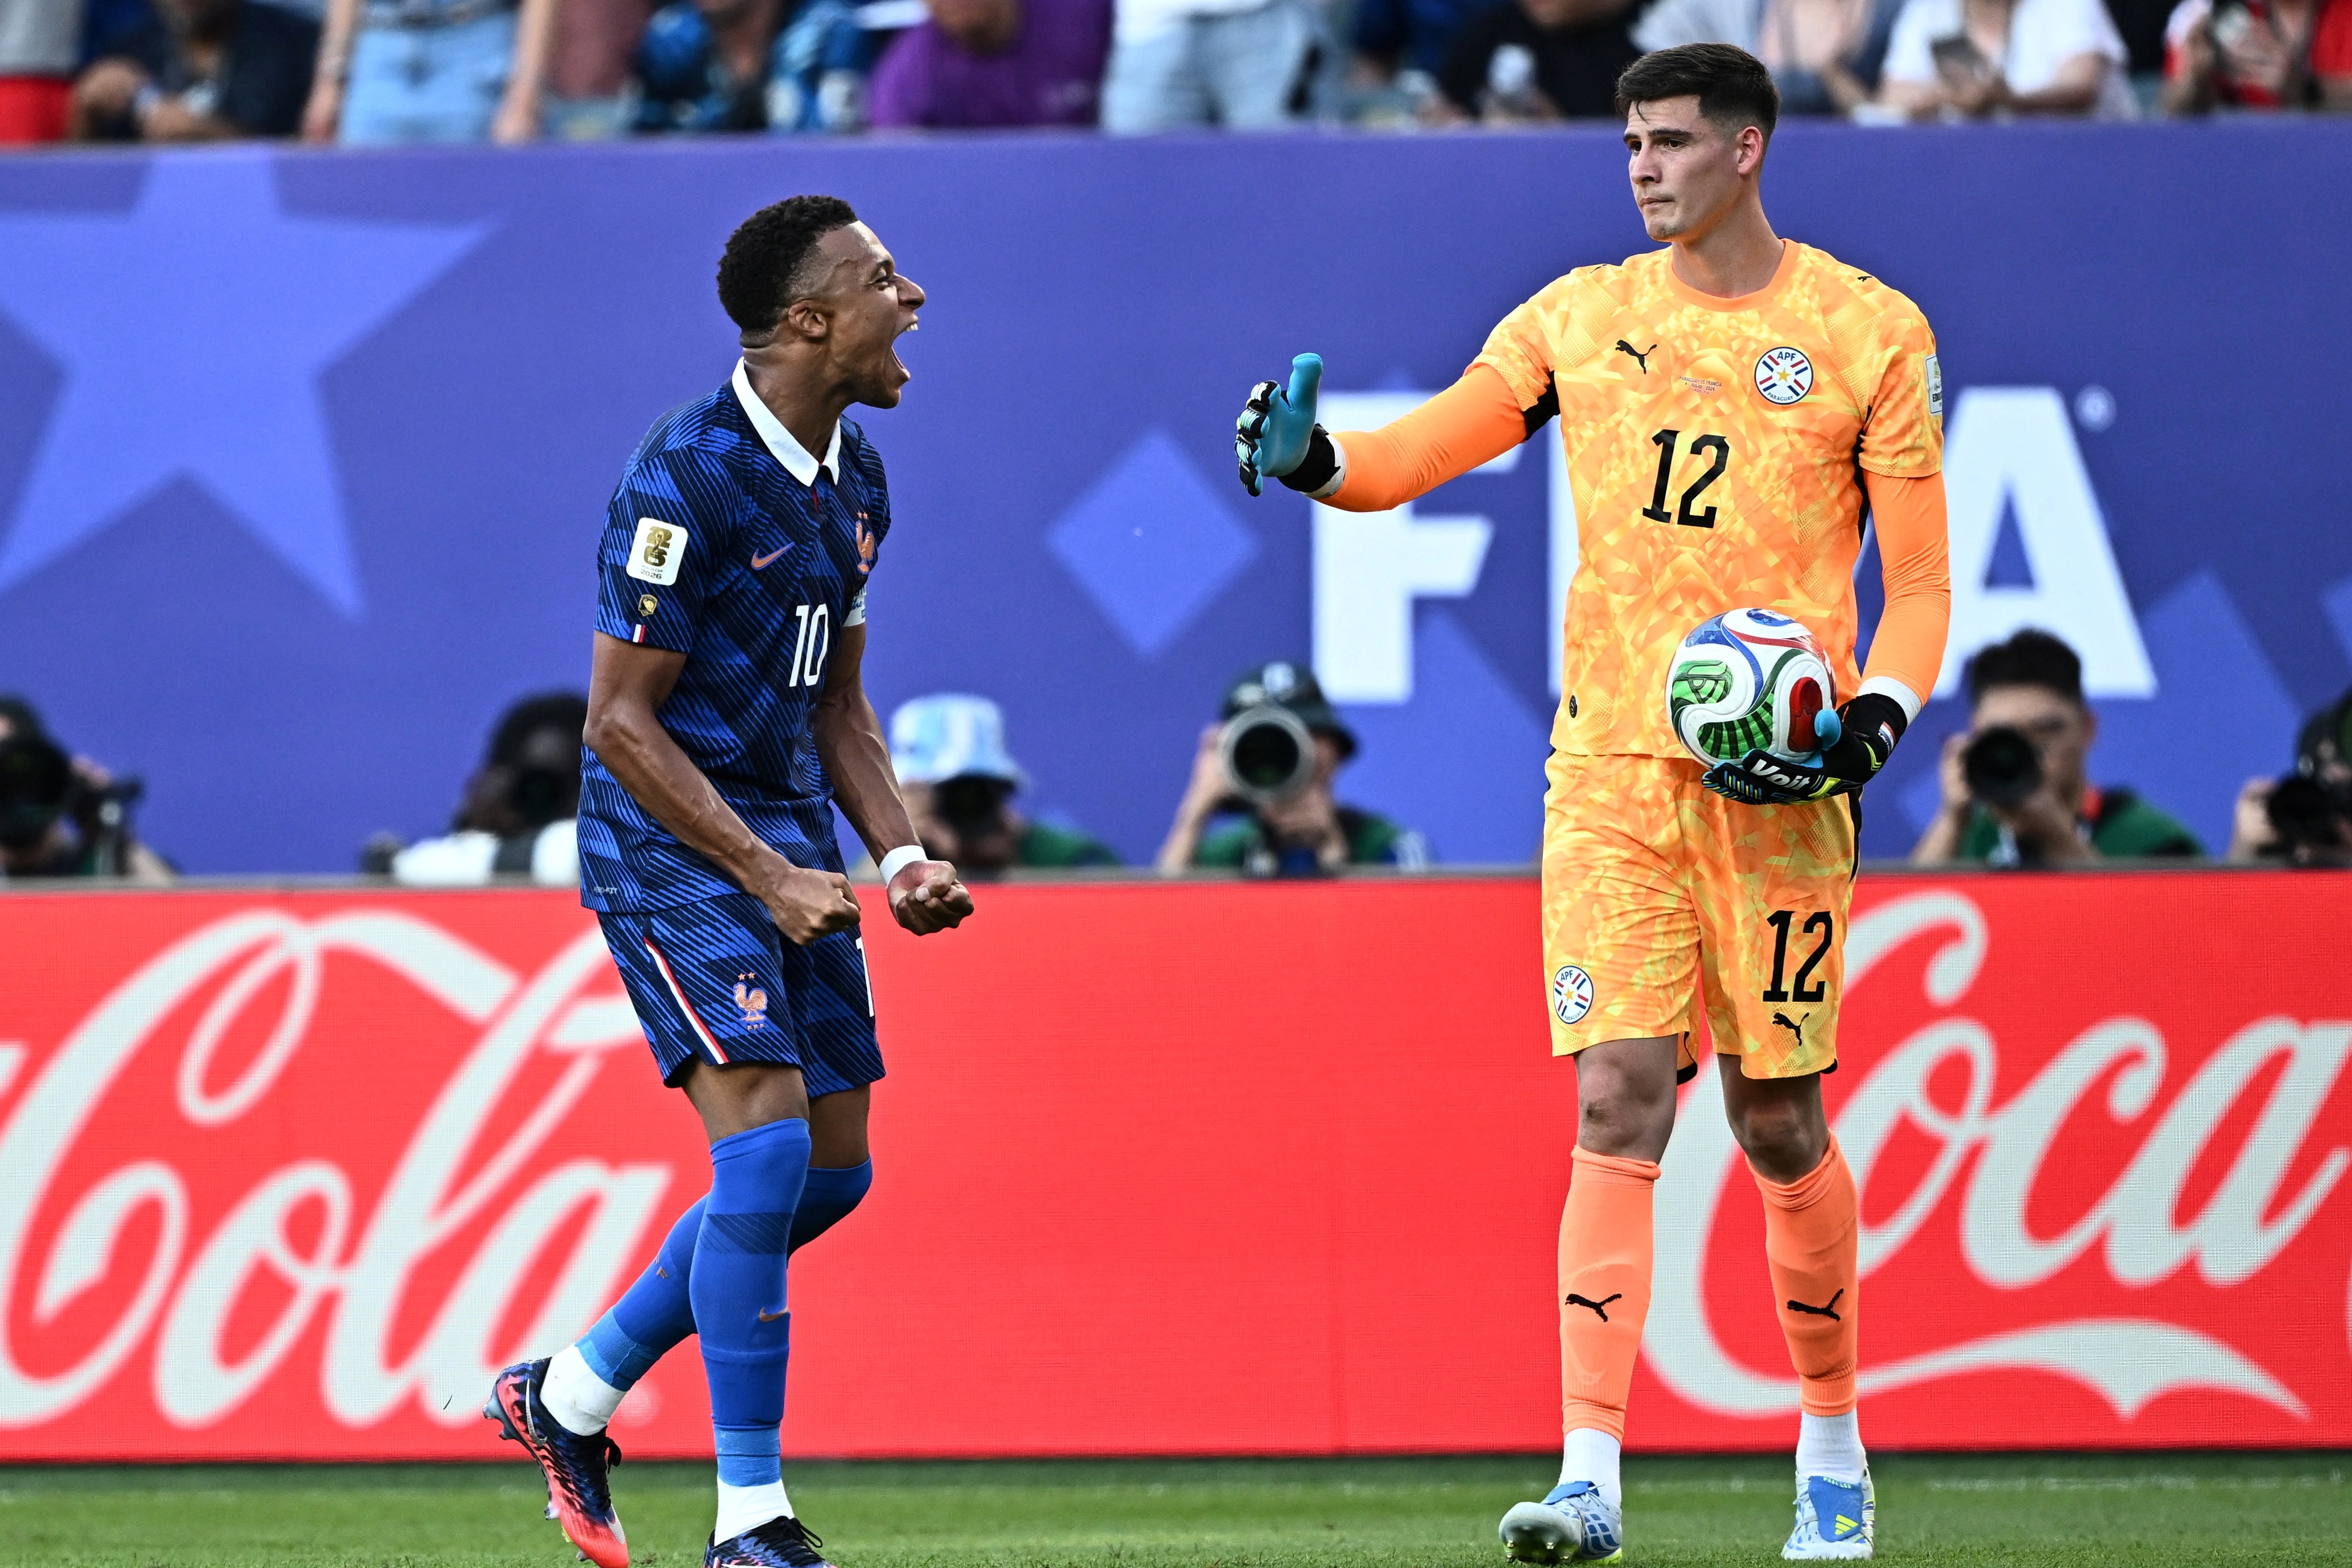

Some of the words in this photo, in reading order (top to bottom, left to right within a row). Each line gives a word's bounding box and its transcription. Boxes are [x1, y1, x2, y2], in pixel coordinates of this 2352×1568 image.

[1777, 351, 1796, 361] APF
[1767, 392, 1793, 401] PARAGUAY
[1643, 429, 1729, 528] 12
[640, 569, 662, 579] 2026
[789, 603, 829, 687] 10
[1750, 759, 1810, 790] Voit
[1763, 911, 1833, 1002] 12
[1560, 970, 1573, 982] APF
[1564, 1010, 1582, 1020] PARAGUAY
